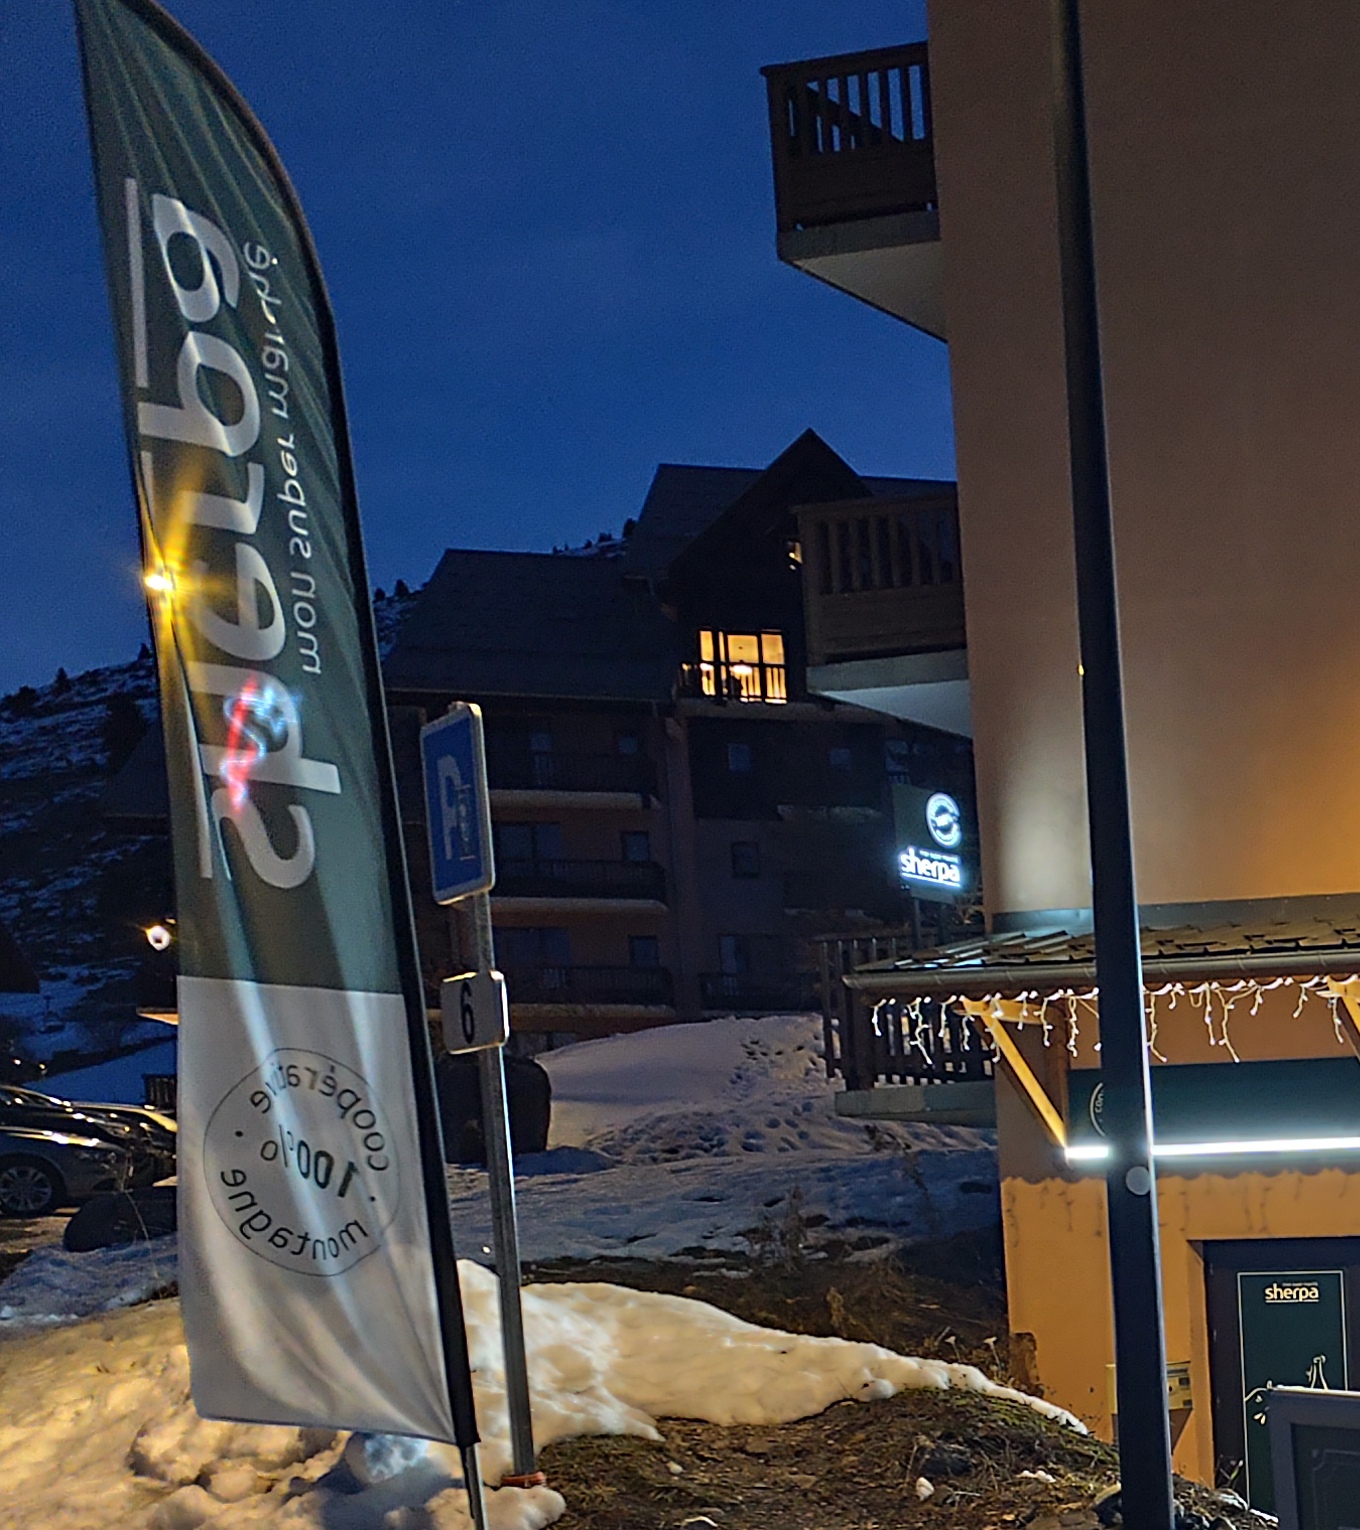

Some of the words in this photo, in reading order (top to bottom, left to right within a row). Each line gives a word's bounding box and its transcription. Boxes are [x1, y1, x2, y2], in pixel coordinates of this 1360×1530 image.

[900, 847, 961, 882] sherpa
[460, 980, 474, 1045] 6
[1265, 1283, 1319, 1302] sherpa
